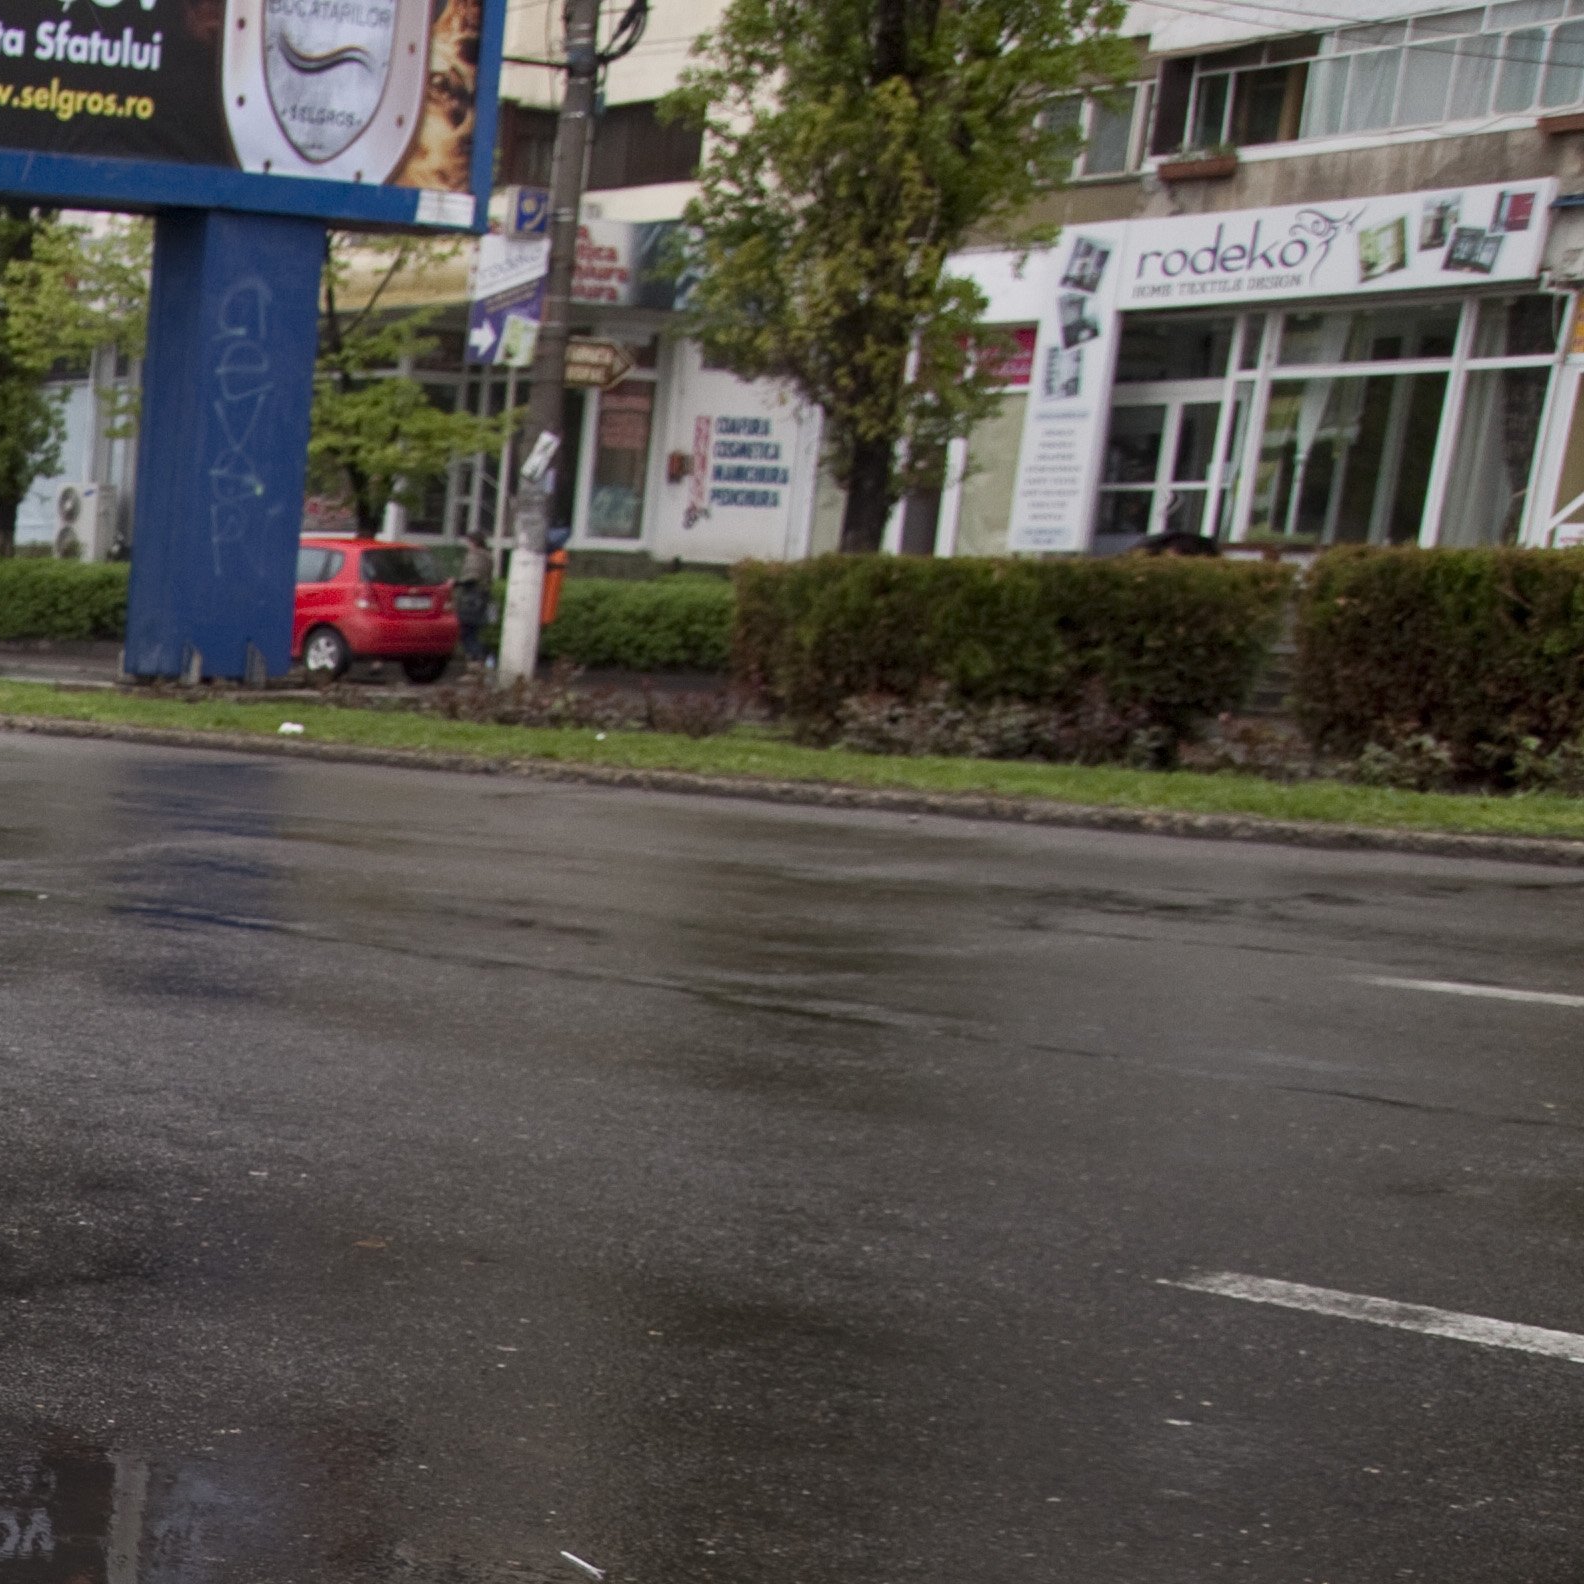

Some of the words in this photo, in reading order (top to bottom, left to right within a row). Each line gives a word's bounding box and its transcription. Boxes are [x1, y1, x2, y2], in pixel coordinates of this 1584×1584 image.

[34, 19, 163, 71] Sfatului
[1136, 219, 1308, 279] rodeko
[1132, 284, 1172, 299] HOME
[1178, 277, 1242, 296] TEXTILE
[1246, 274, 1302, 290] DESIGN
